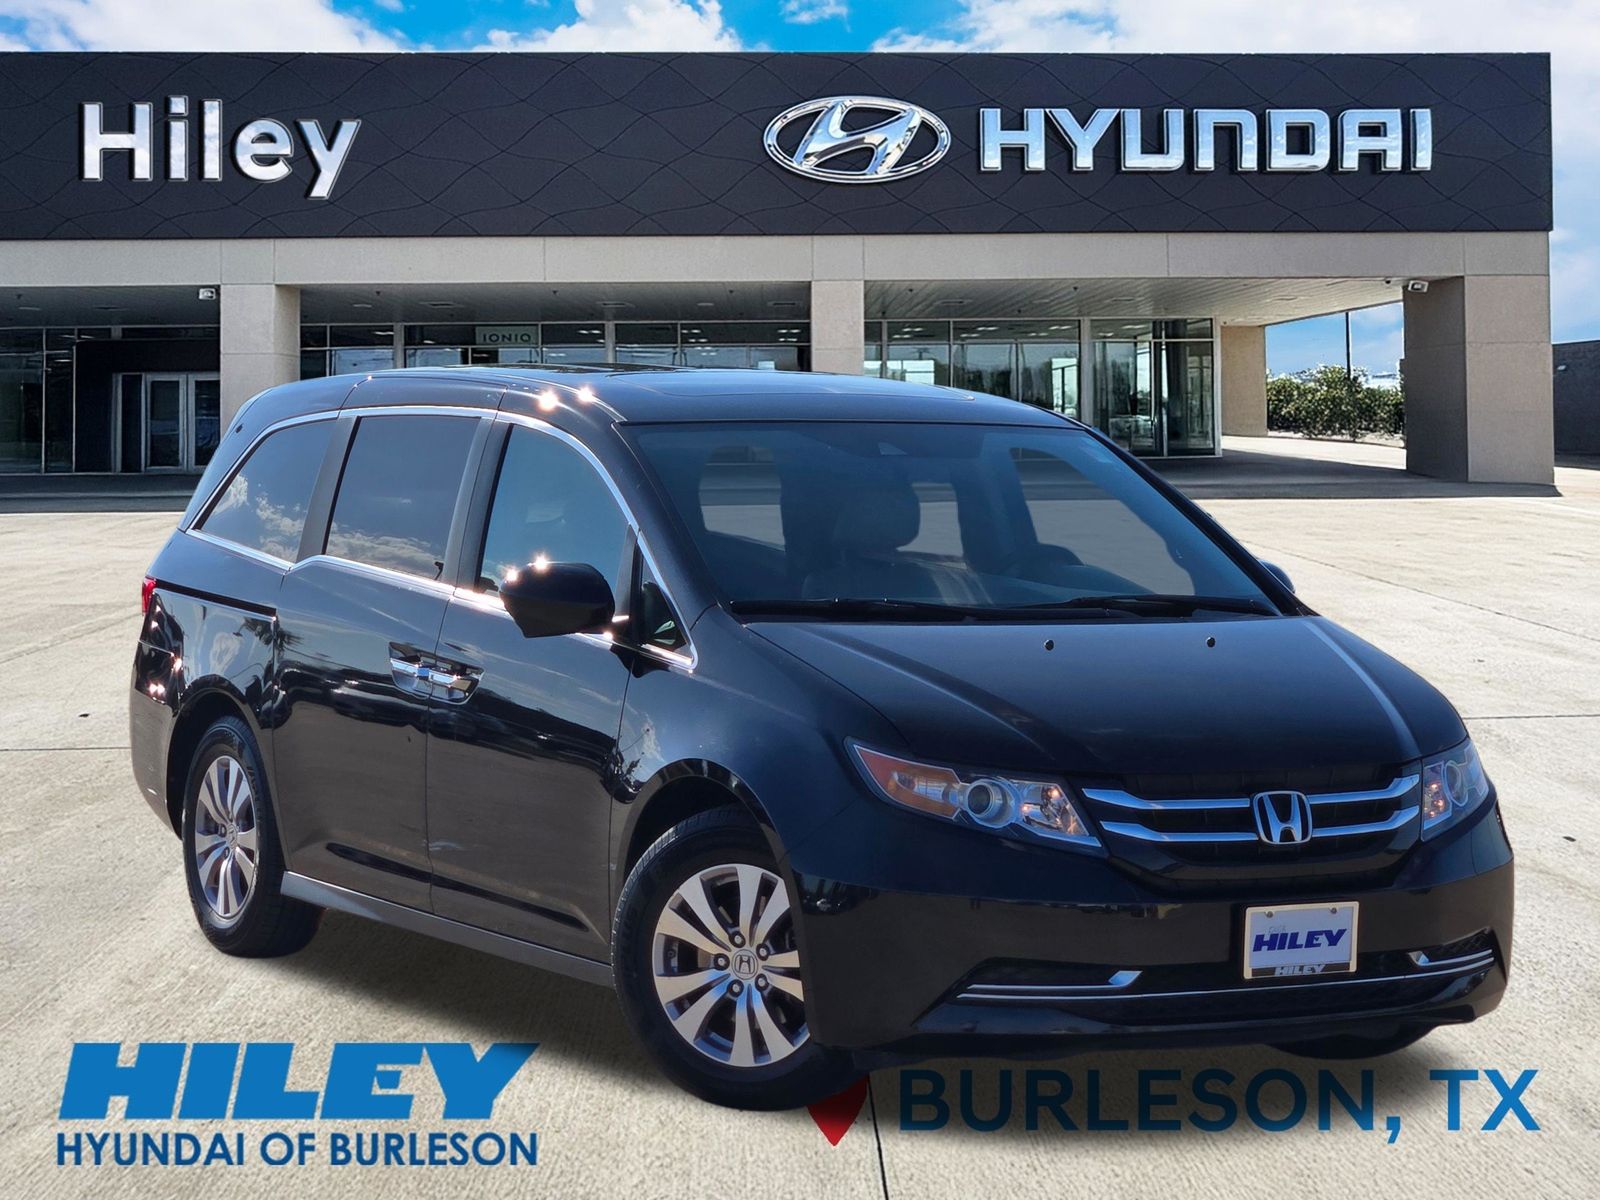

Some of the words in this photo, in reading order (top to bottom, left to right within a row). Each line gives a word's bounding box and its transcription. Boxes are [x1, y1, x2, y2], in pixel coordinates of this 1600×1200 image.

[81, 95, 361, 200] Hiley
[979, 108, 1433, 172] HYUNDAI
[1252, 928, 1347, 952] HILEY
[1274, 964, 1326, 977] HILEY
